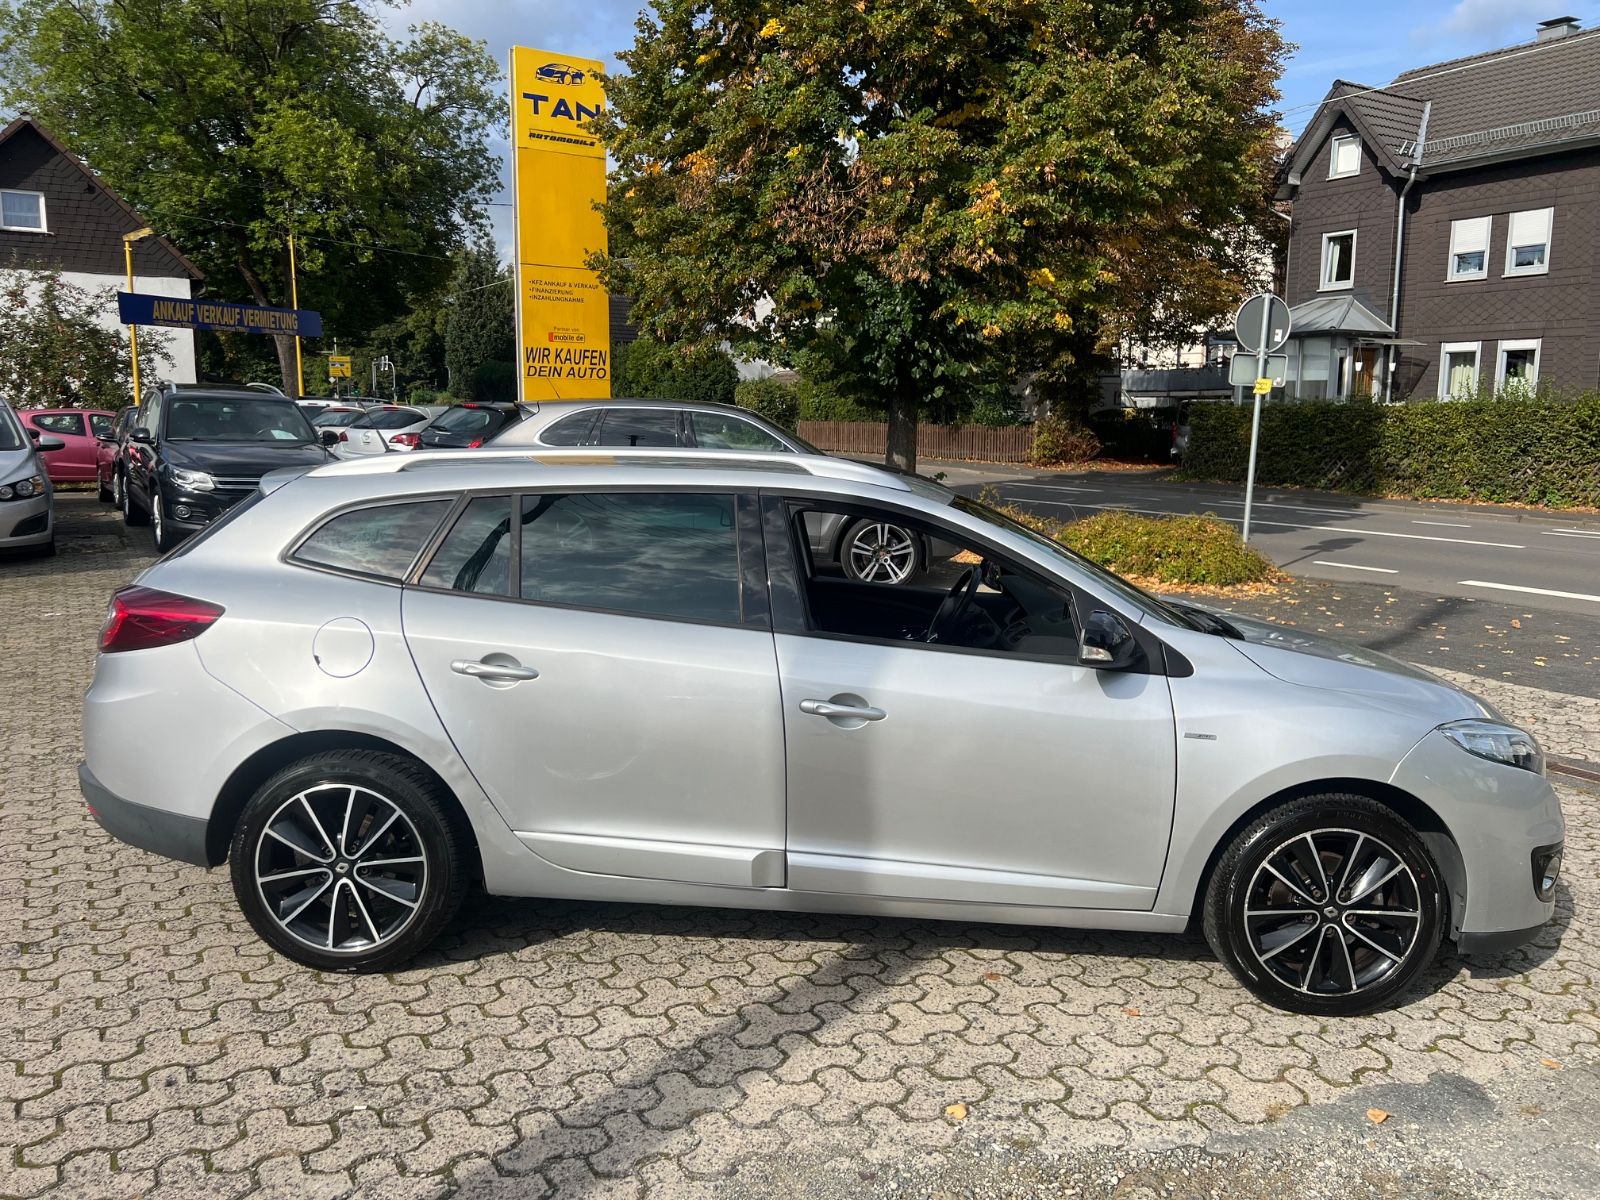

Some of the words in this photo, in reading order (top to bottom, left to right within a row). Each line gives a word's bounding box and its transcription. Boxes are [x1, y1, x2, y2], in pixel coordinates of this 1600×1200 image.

[523, 92, 600, 121] TAN
[529, 132, 596, 146] AUTOMOBILE
[532, 287, 573, 295] FINANZIERUNG
[153, 301, 194, 321] ANKAUF
[197, 304, 241, 326] VERKAUF
[242, 308, 298, 330] VERMIETUNG
[525, 346, 551, 364] WIR
[555, 348, 607, 366] KAUFEN
[527, 366, 562, 377] DEIN
[566, 367, 606, 378] AUTO
